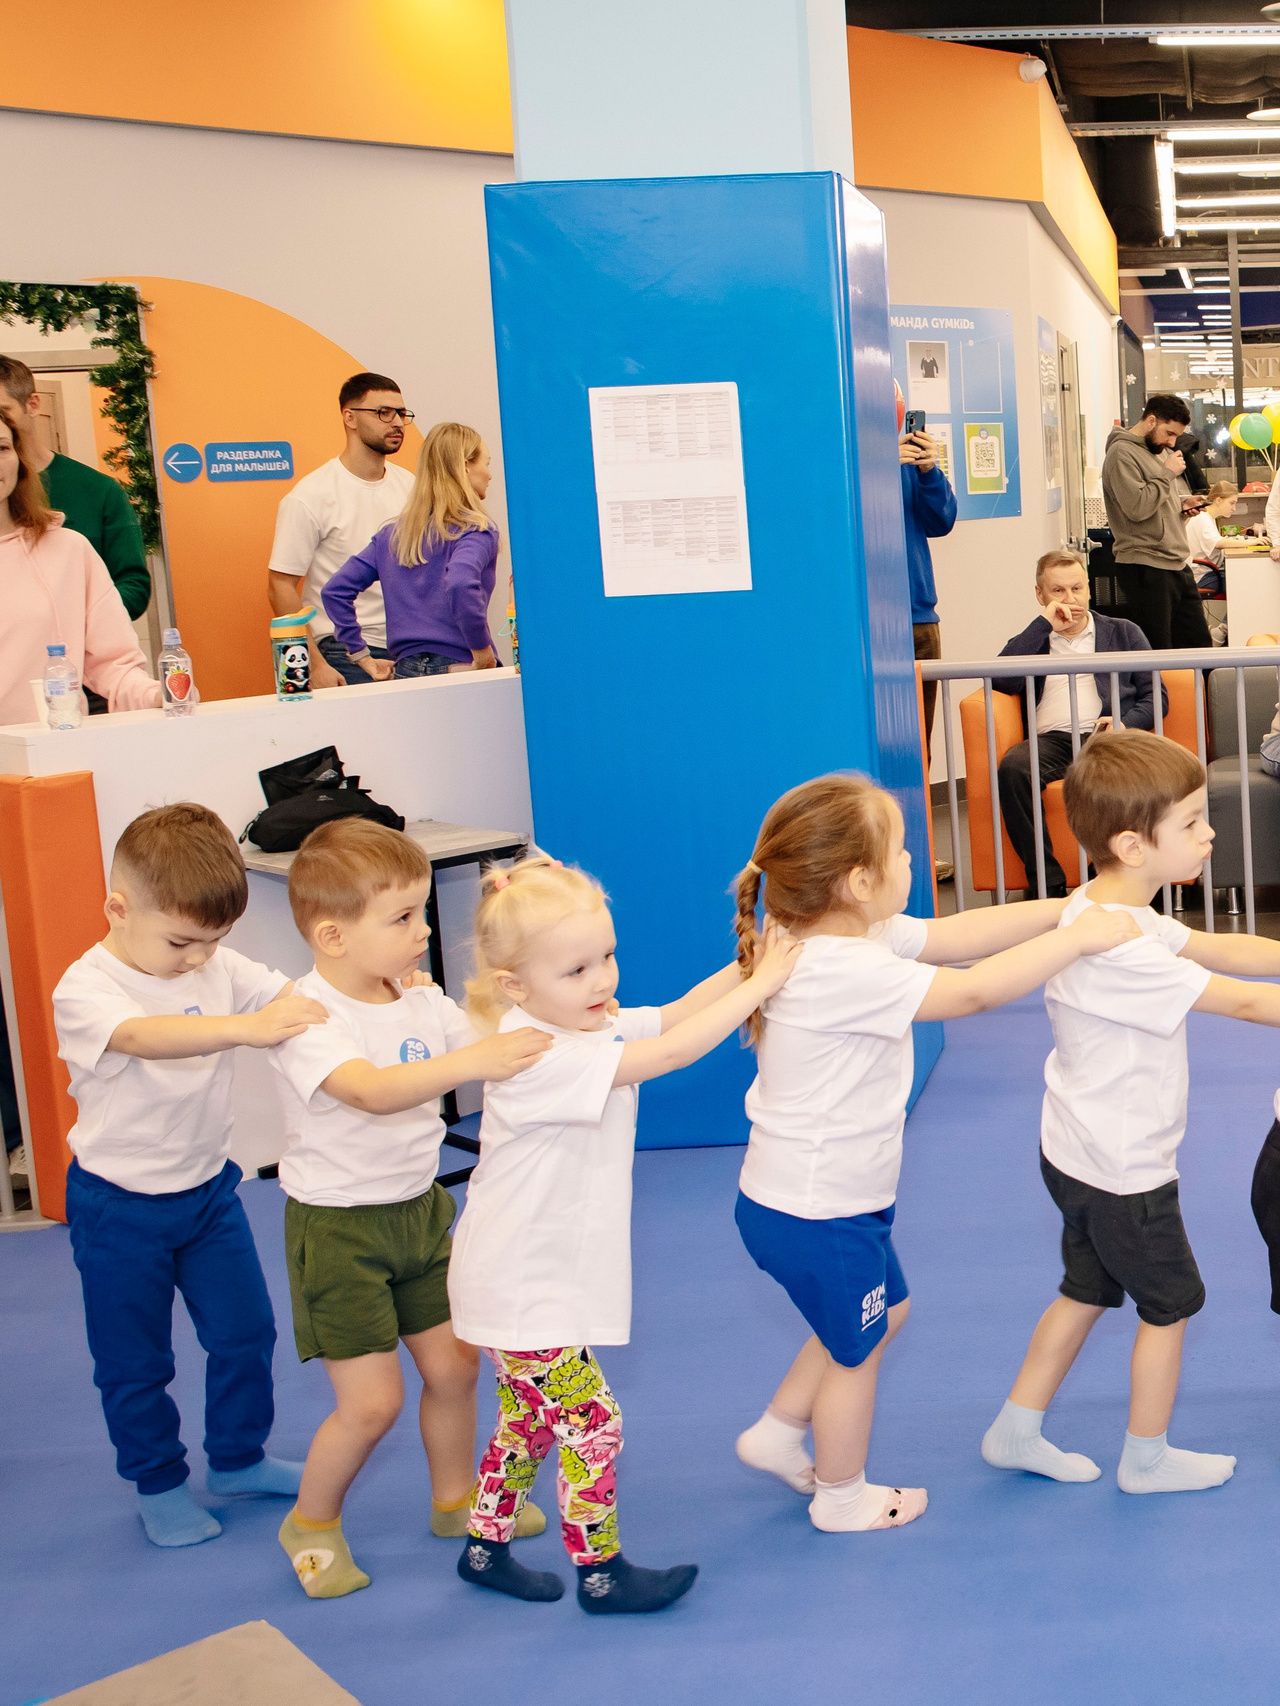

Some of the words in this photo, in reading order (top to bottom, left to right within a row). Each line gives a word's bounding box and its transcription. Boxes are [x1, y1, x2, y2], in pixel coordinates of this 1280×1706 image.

[931, 317, 975, 330] GYMKiDs
[216, 450, 282, 461] РАЗДЕВАЛКА
[210, 463, 233, 474] ДЛЯ
[234, 460, 290, 472] МАЛЫШЕЙ
[862, 1281, 886, 1310] GYM
